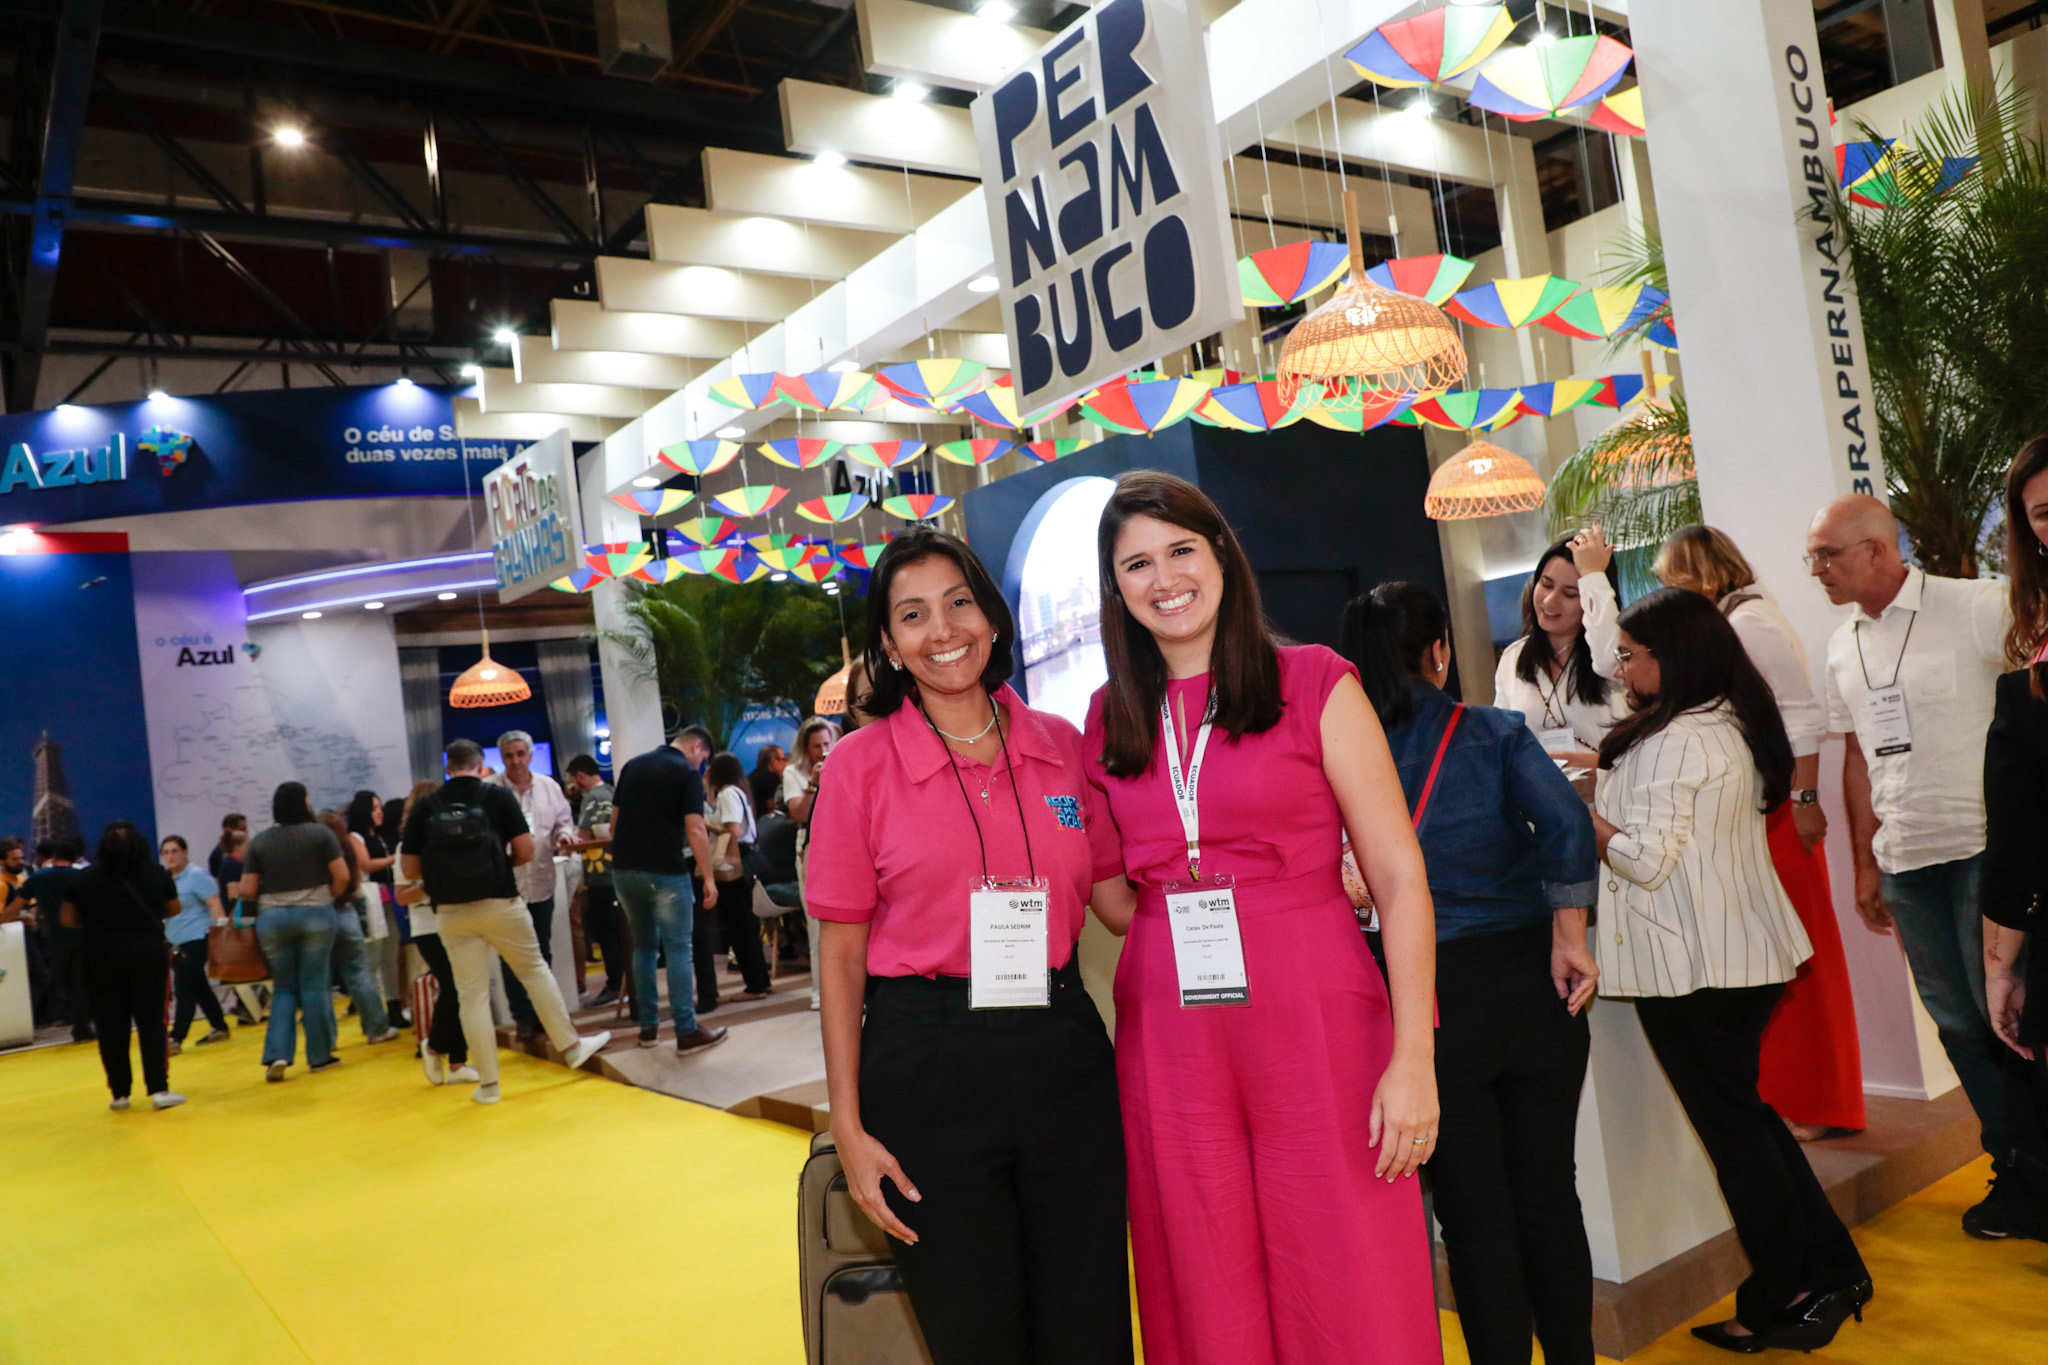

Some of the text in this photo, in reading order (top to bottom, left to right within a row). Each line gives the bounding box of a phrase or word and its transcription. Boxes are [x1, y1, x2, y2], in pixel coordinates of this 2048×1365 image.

[993, 0, 1153, 184] PER
[1786, 45, 1859, 398] PERNAMBUCO
[1014, 214, 1196, 397] BUCO
[344, 427, 363, 444] O
[367, 425, 404, 443] céu
[408, 423, 435, 442] de
[0, 432, 126, 493] Azul
[346, 447, 396, 463] duas
[401, 447, 458, 461] vezes
[462, 444, 509, 460] mais
[490, 462, 539, 536] PORTO
[155, 636, 167, 648] o
[171, 633, 200, 647] céu
[176, 645, 235, 667] Azul
[1172, 766, 1184, 801] ECUADOR
[1188, 765, 1198, 801] ECUADOR
[1020, 898, 1043, 908] wtm
[1208, 897, 1230, 907] wtm
[1184, 993, 1220, 1001] GOVERNMENT
